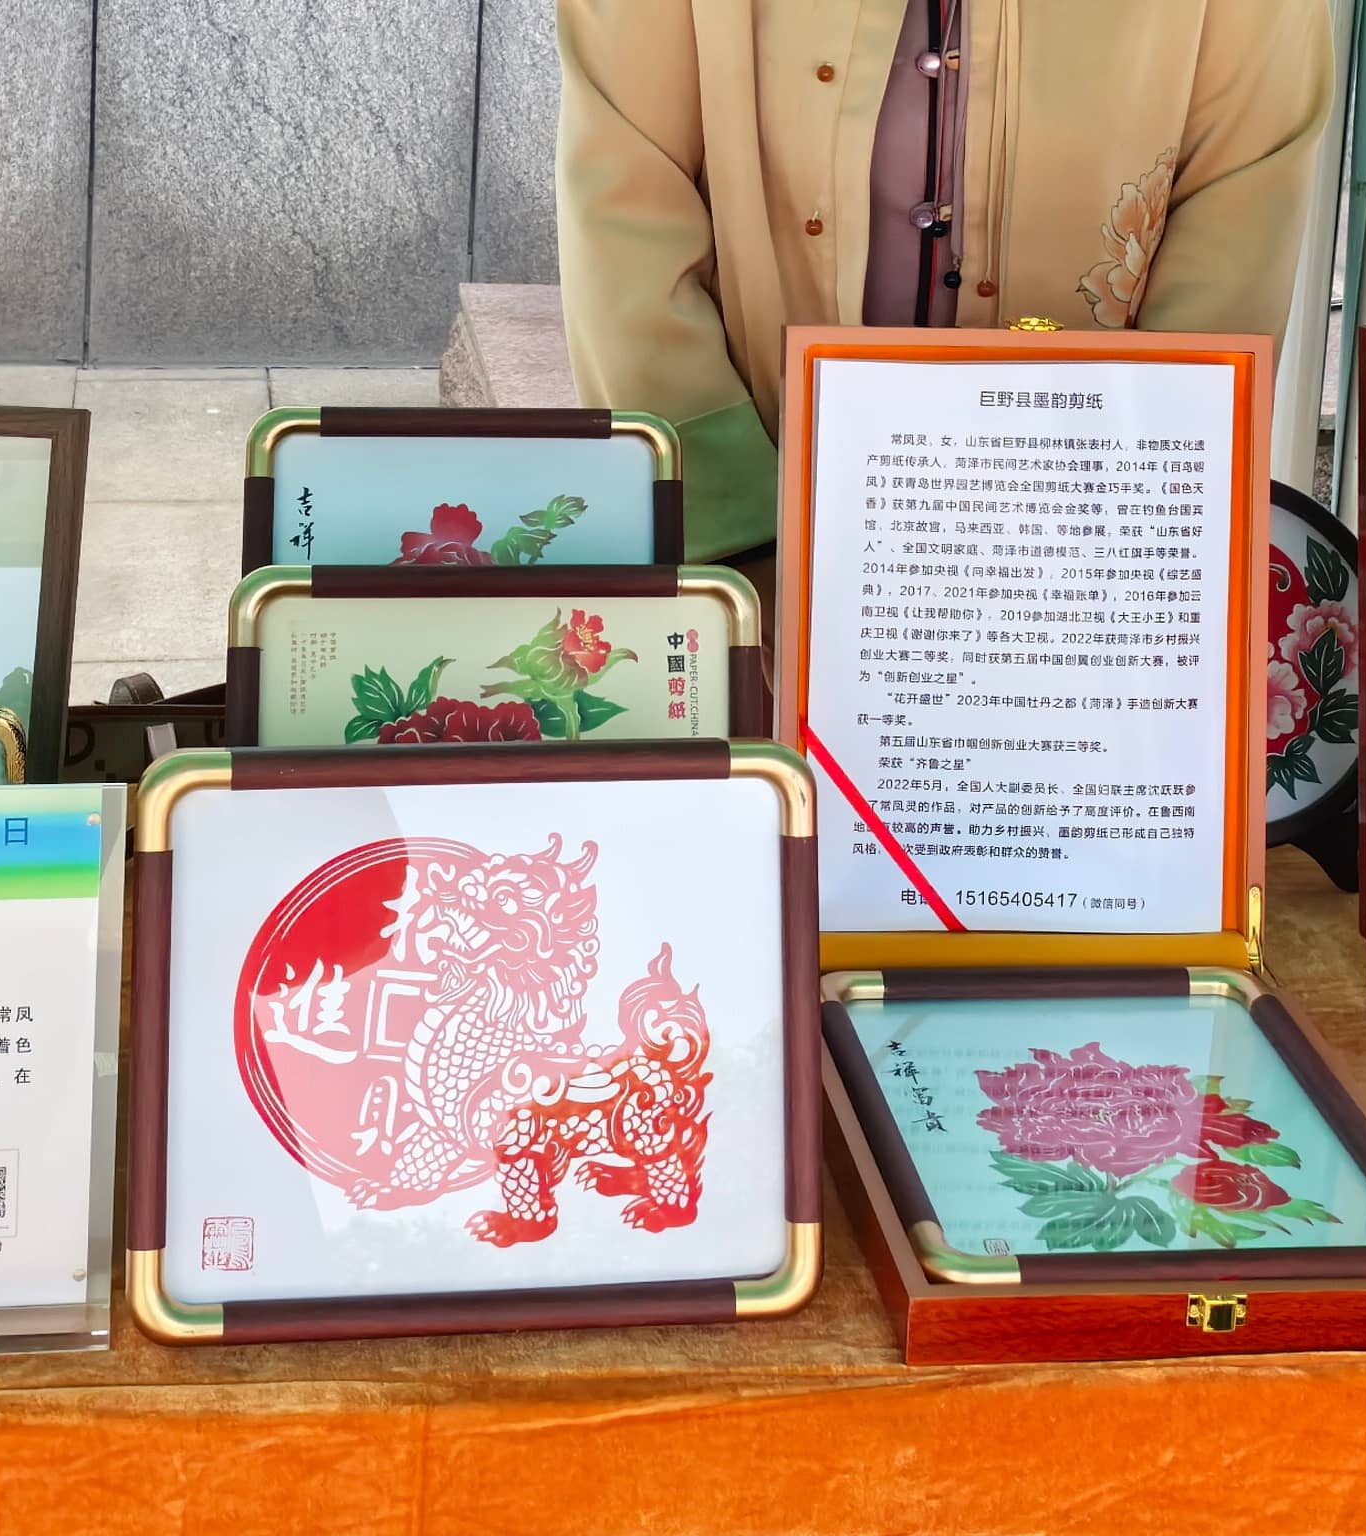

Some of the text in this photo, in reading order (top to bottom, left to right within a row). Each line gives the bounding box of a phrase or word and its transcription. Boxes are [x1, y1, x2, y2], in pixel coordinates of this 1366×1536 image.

[979, 390, 1104, 411] 巨野县墨韵剪纸
[289, 485, 315, 561] 吉祥
